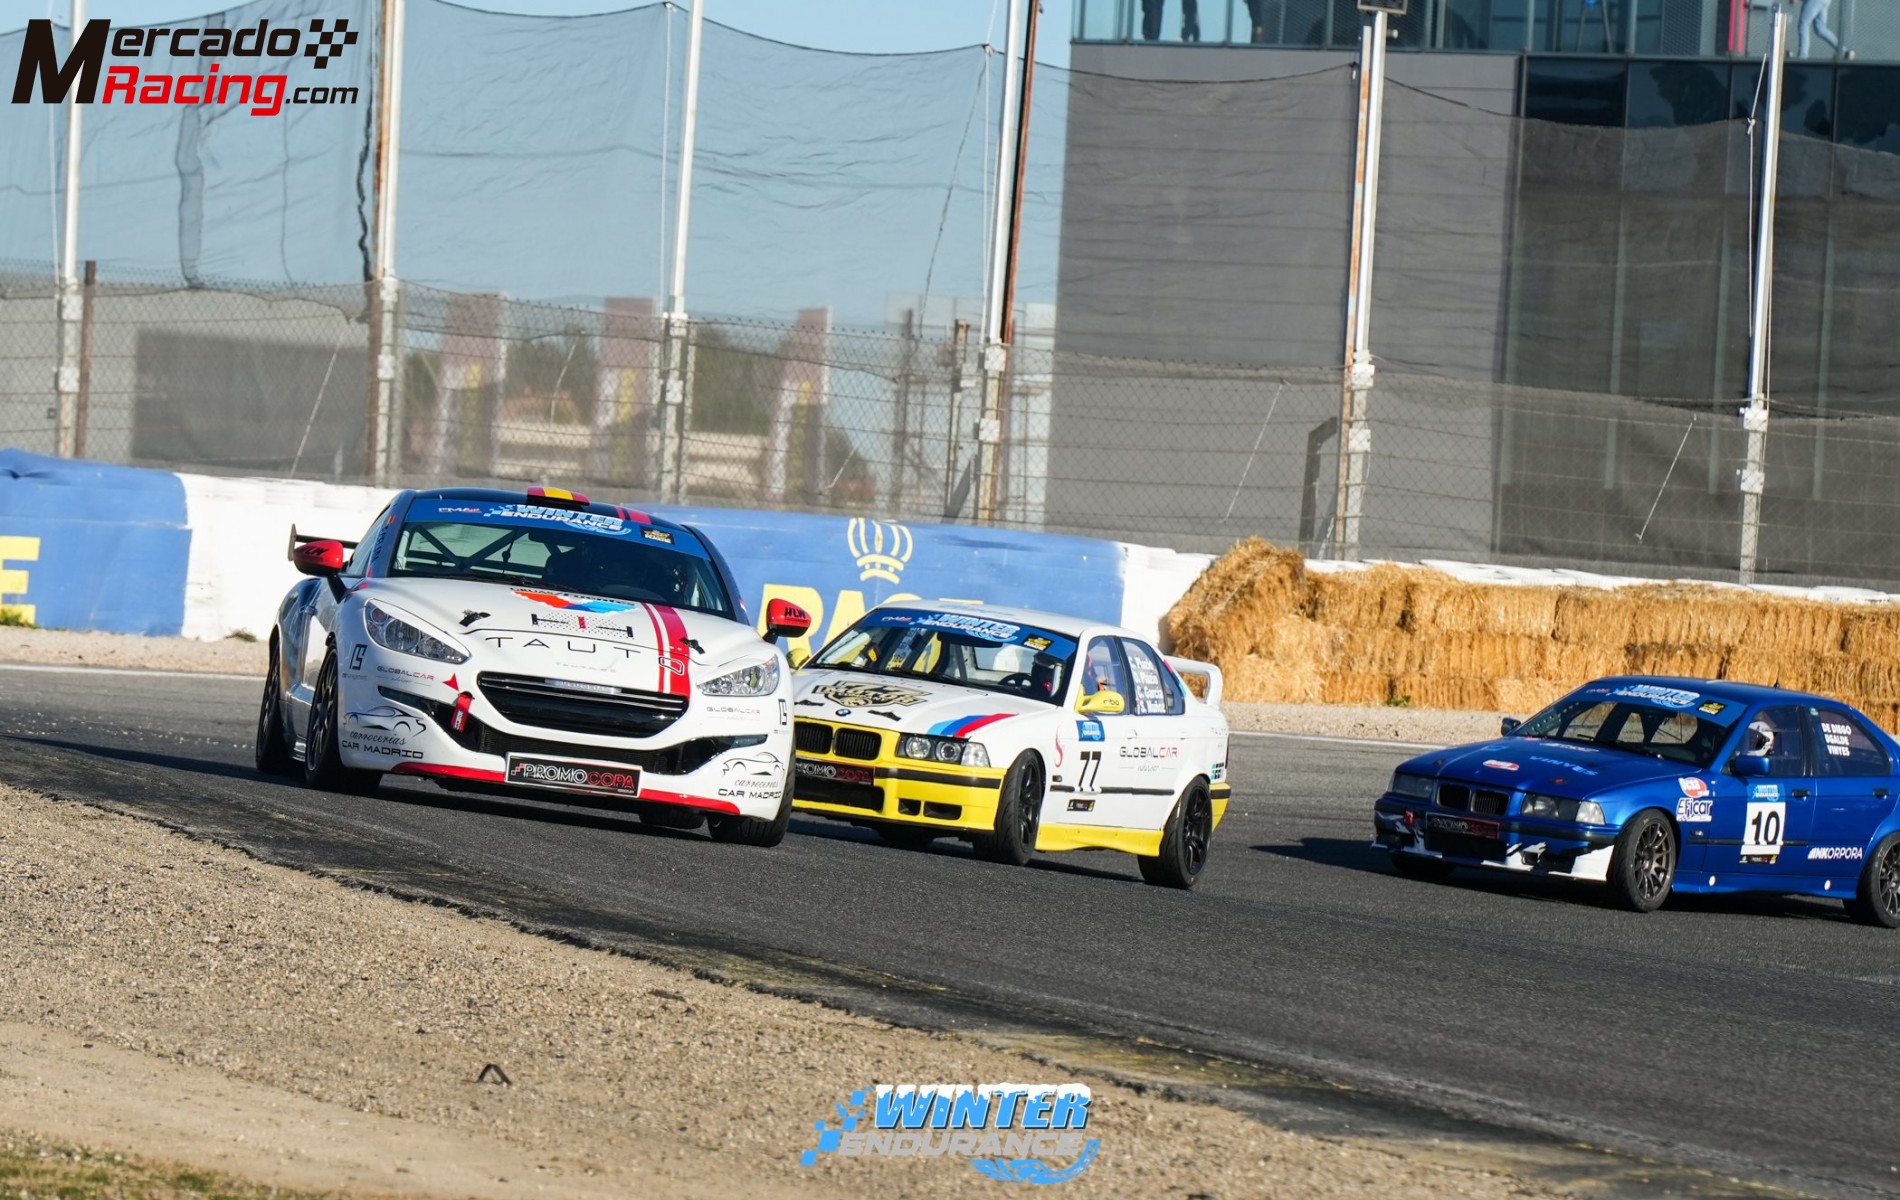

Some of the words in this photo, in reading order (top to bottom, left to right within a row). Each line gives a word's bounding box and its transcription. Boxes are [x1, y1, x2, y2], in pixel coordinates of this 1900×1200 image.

[500, 511, 623, 531] ENDURANCE
[515, 504, 624, 526] WINTER
[756, 583, 984, 659] RA
[923, 619, 1013, 638] ENDURANCE
[939, 614, 1020, 634] WINTER
[485, 637, 684, 675] TAUTO
[1831, 723, 1852, 735] DIEGO
[342, 740, 359, 750] CAR
[364, 744, 424, 760] MADRID
[1120, 746, 1178, 758] GLOBALCAR
[1827, 744, 1850, 757] VINYES
[523, 763, 635, 789] PROMOCOPA
[796, 762, 872, 782] ROMOCOPA
[1078, 751, 1102, 792] 77
[718, 788, 745, 798] CAR
[1752, 811, 1780, 845] 10
